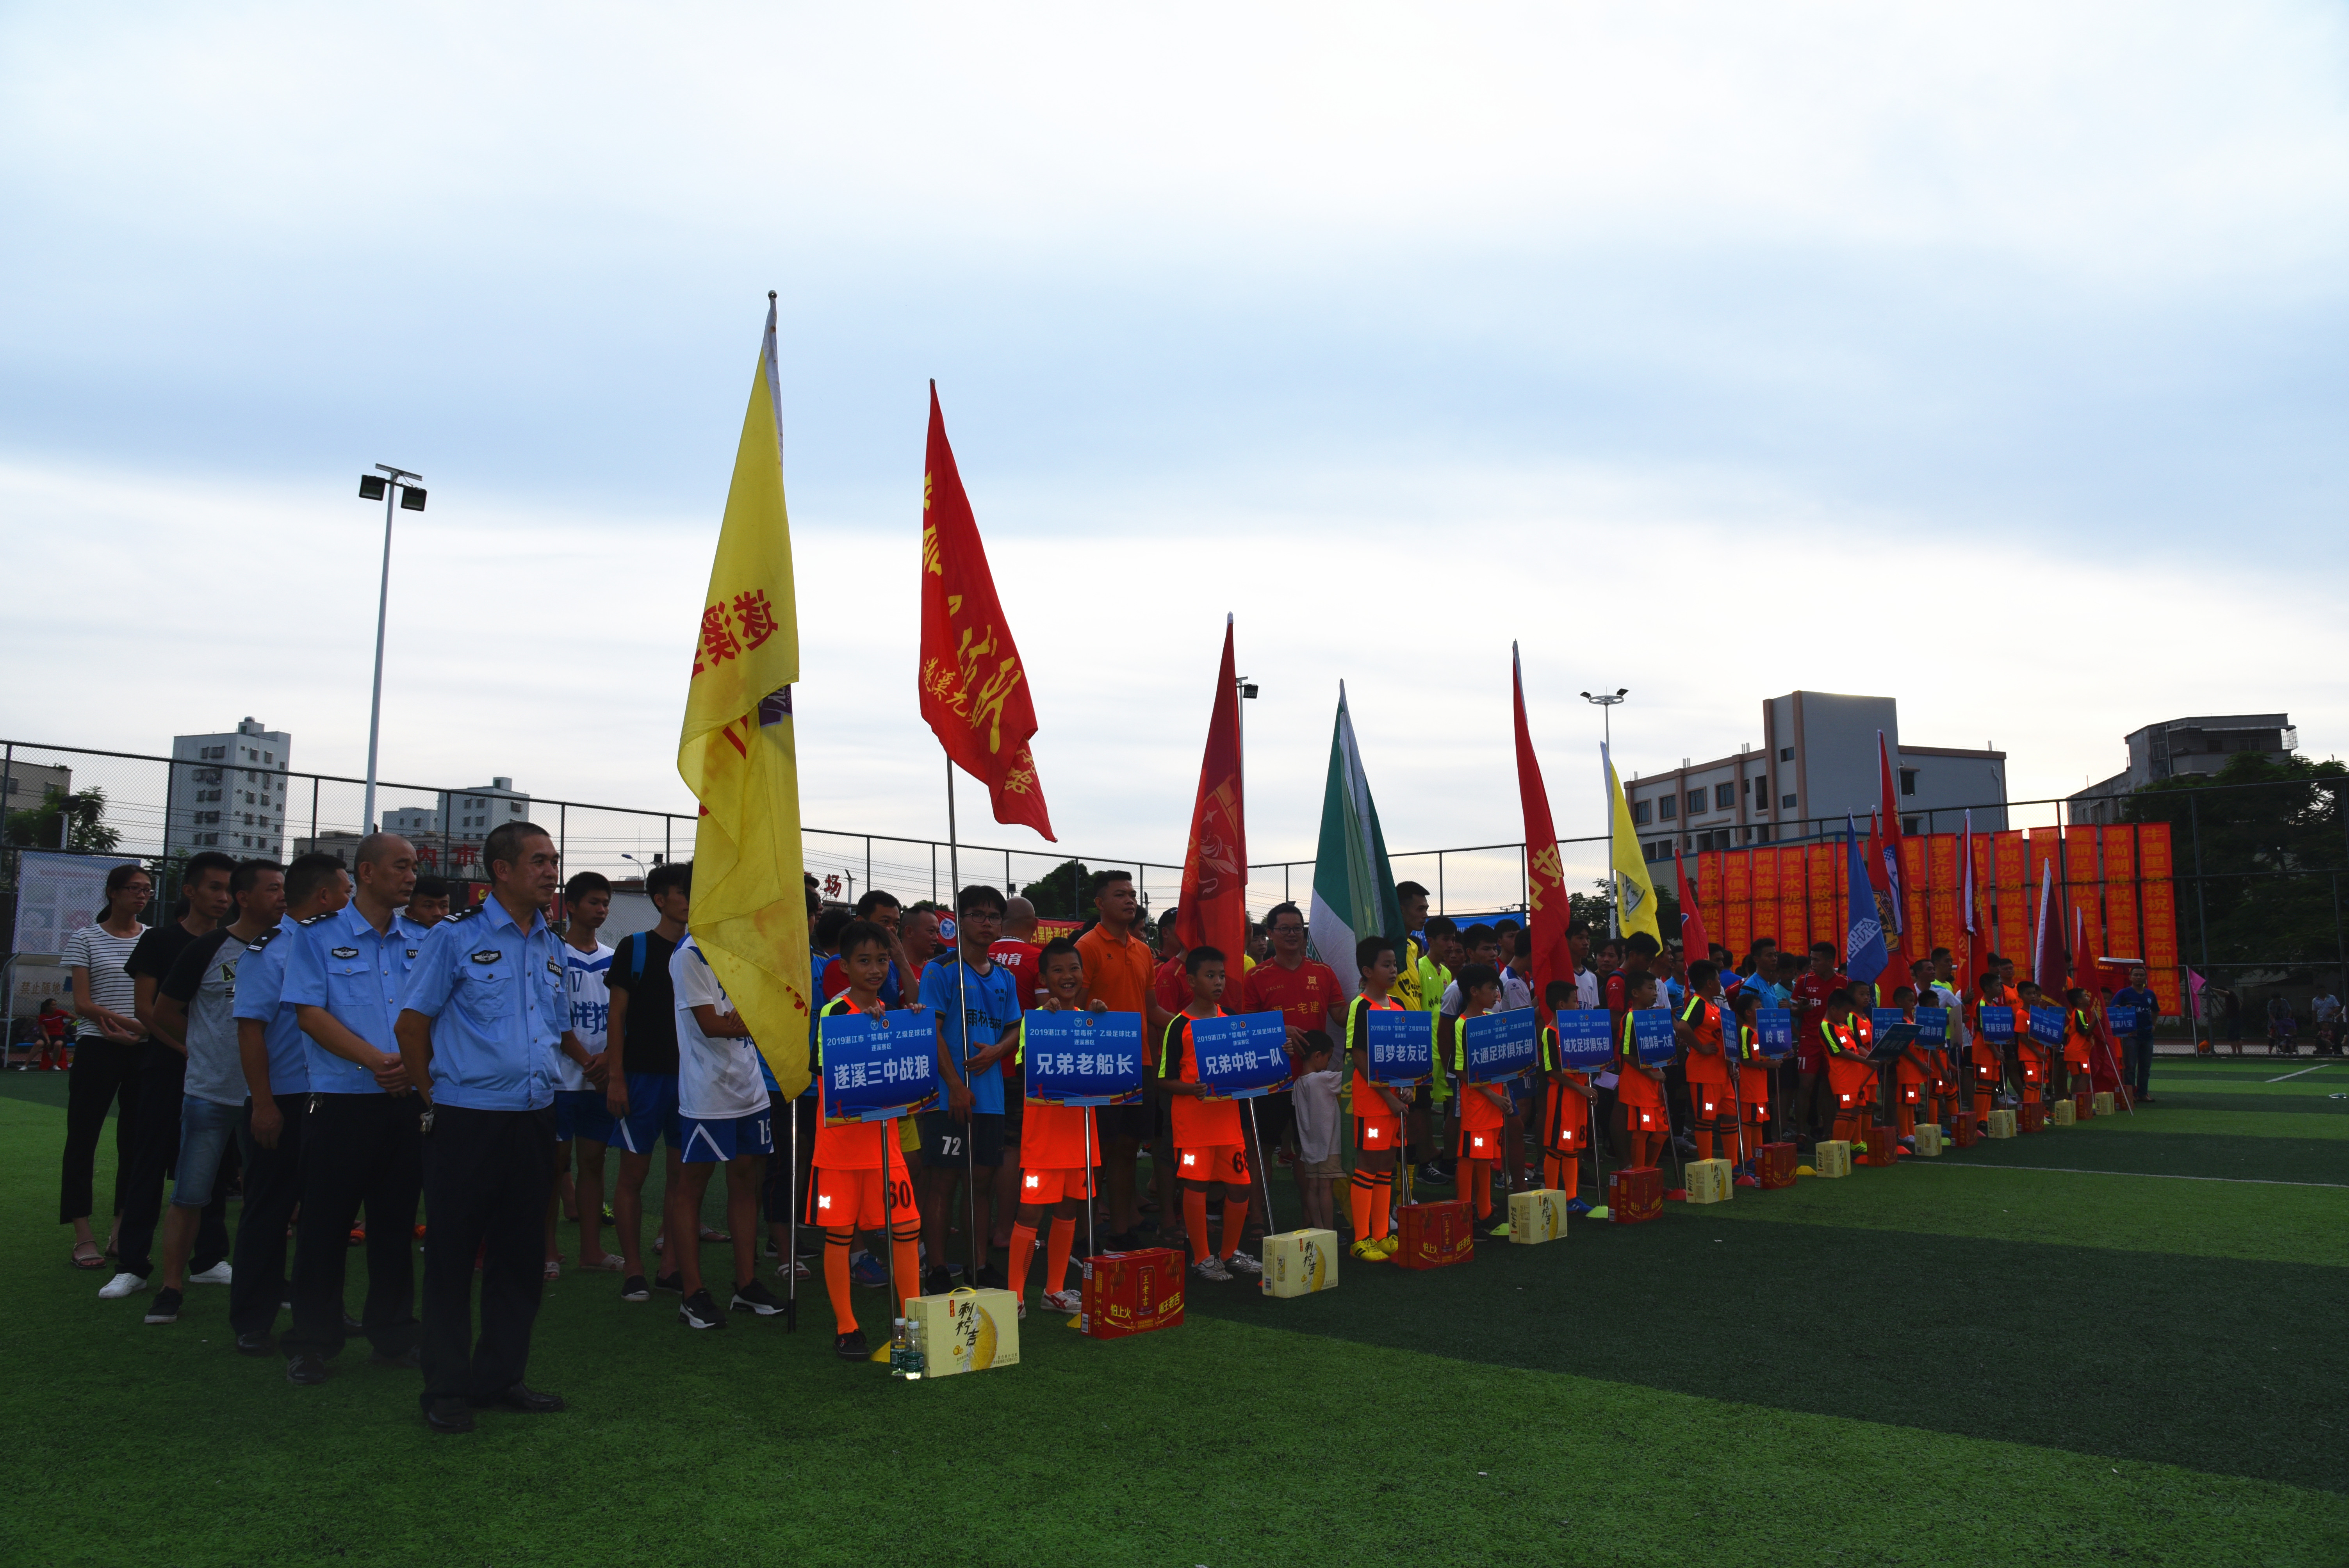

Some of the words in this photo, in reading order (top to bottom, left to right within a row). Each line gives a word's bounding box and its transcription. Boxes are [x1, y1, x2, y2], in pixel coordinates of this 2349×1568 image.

[570, 971, 583, 992] 17
[827, 1028, 932, 1046] 2019湛江市“禁毒杯”乙级足球比赛
[1030, 1028, 1137, 1037] 2019湛江市“禁毒杯”乙级足球比赛
[1197, 1026, 1282, 1043] 2019湛江市“禁毒杯”乙级足球比赛
[1985, 1023, 2012, 1033] 美丽足球队
[2033, 1021, 2058, 1039] 润丰水泥
[871, 1043, 891, 1051] 遂溪赛区
[1374, 1044, 1428, 1062] 圆梦老友记
[1471, 1038, 1533, 1066] 大通足球俱乐部
[1563, 1037, 1610, 1053] 域龙足球俱乐部
[1036, 1053, 1134, 1075] 兄弟老船长
[1205, 1047, 1283, 1076] 兄弟中锐一队
[834, 1054, 930, 1090] 遂溪三中战狼
[1523, 1076, 1531, 1089] 10
[758, 1118, 772, 1145] 15
[942, 1136, 961, 1156] 72
[883, 1180, 911, 1209] 60
[1303, 1240, 1317, 1275] 刺柠吉
[1423, 1242, 1438, 1255] 怕上火
[1110, 1303, 1132, 1320] 怕上火
[1159, 1292, 1181, 1315] 喝王老吉
[955, 1301, 980, 1347] 刺柠吉
